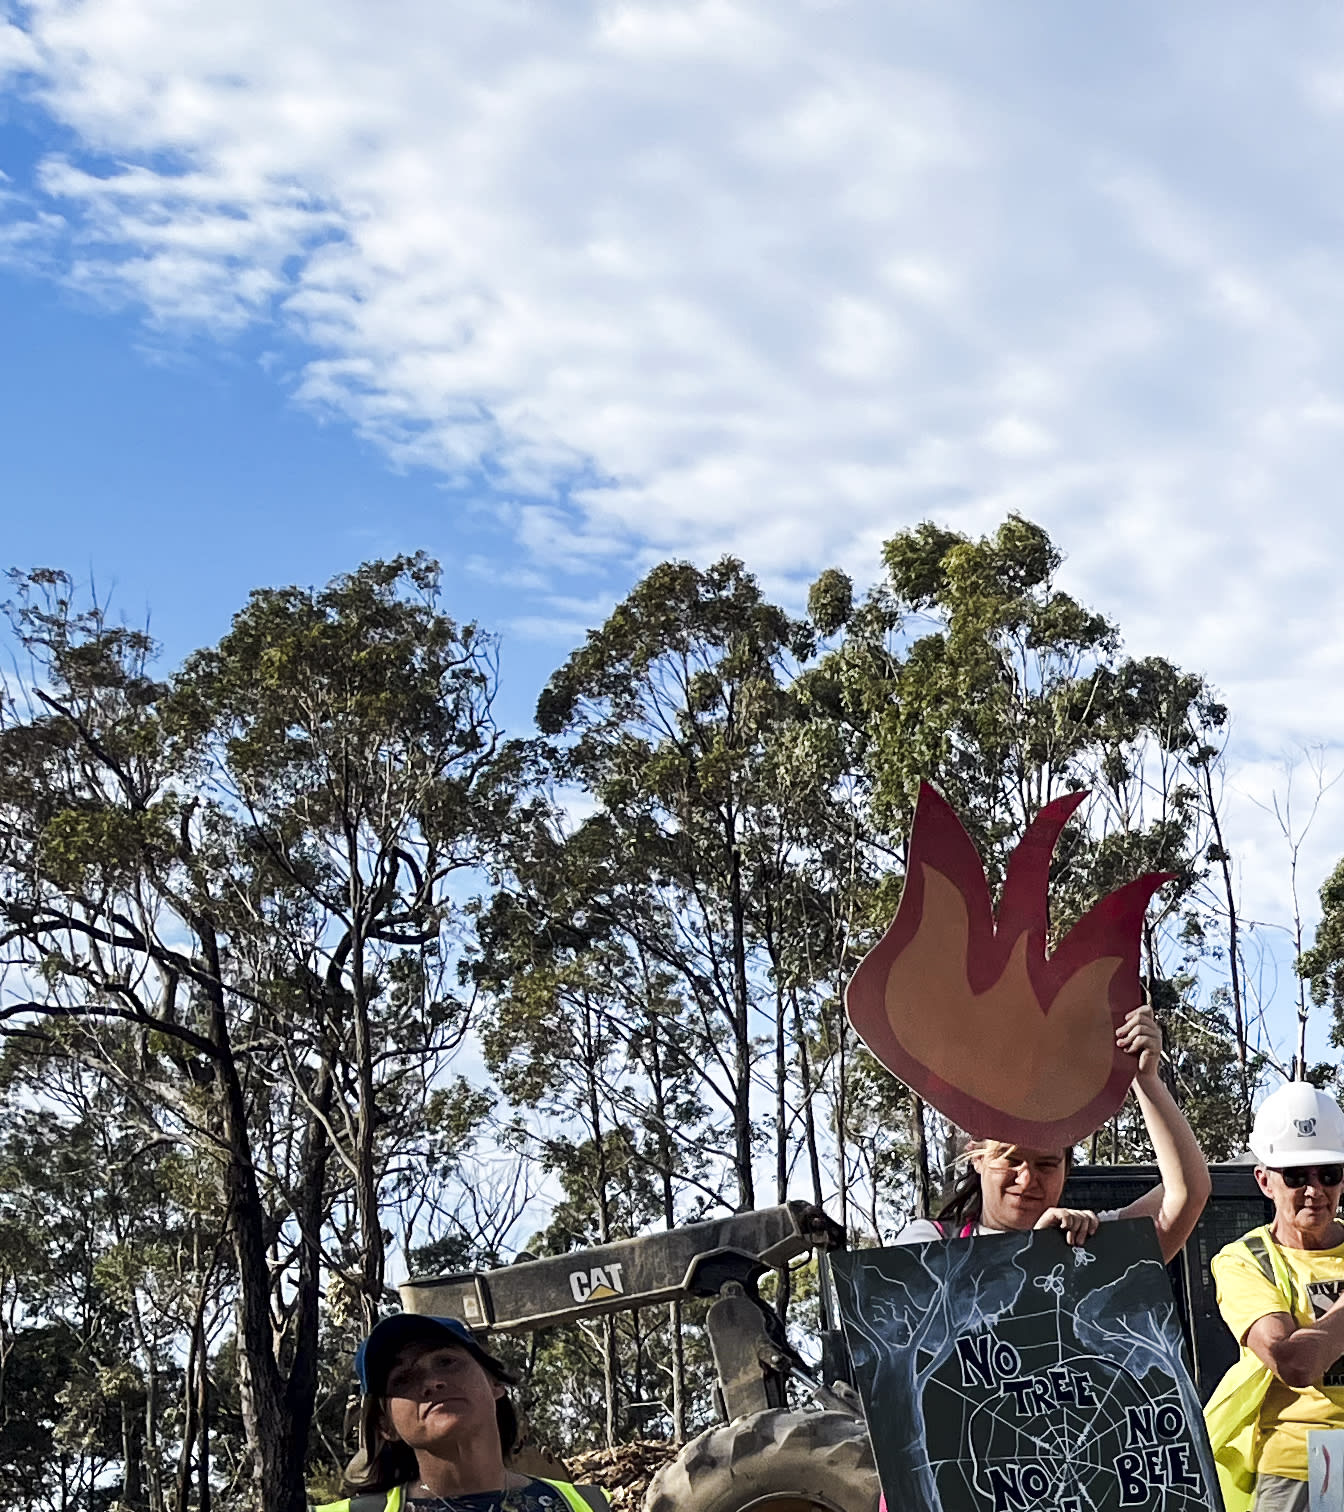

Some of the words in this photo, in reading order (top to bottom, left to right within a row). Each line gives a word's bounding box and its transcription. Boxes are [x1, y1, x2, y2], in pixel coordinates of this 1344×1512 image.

[569, 1263, 624, 1302] CAT
[955, 1332, 1020, 1388] NO
[1000, 1368, 1099, 1416] TREE
[1125, 1403, 1184, 1449] NO
[1113, 1443, 1201, 1507] BEE
